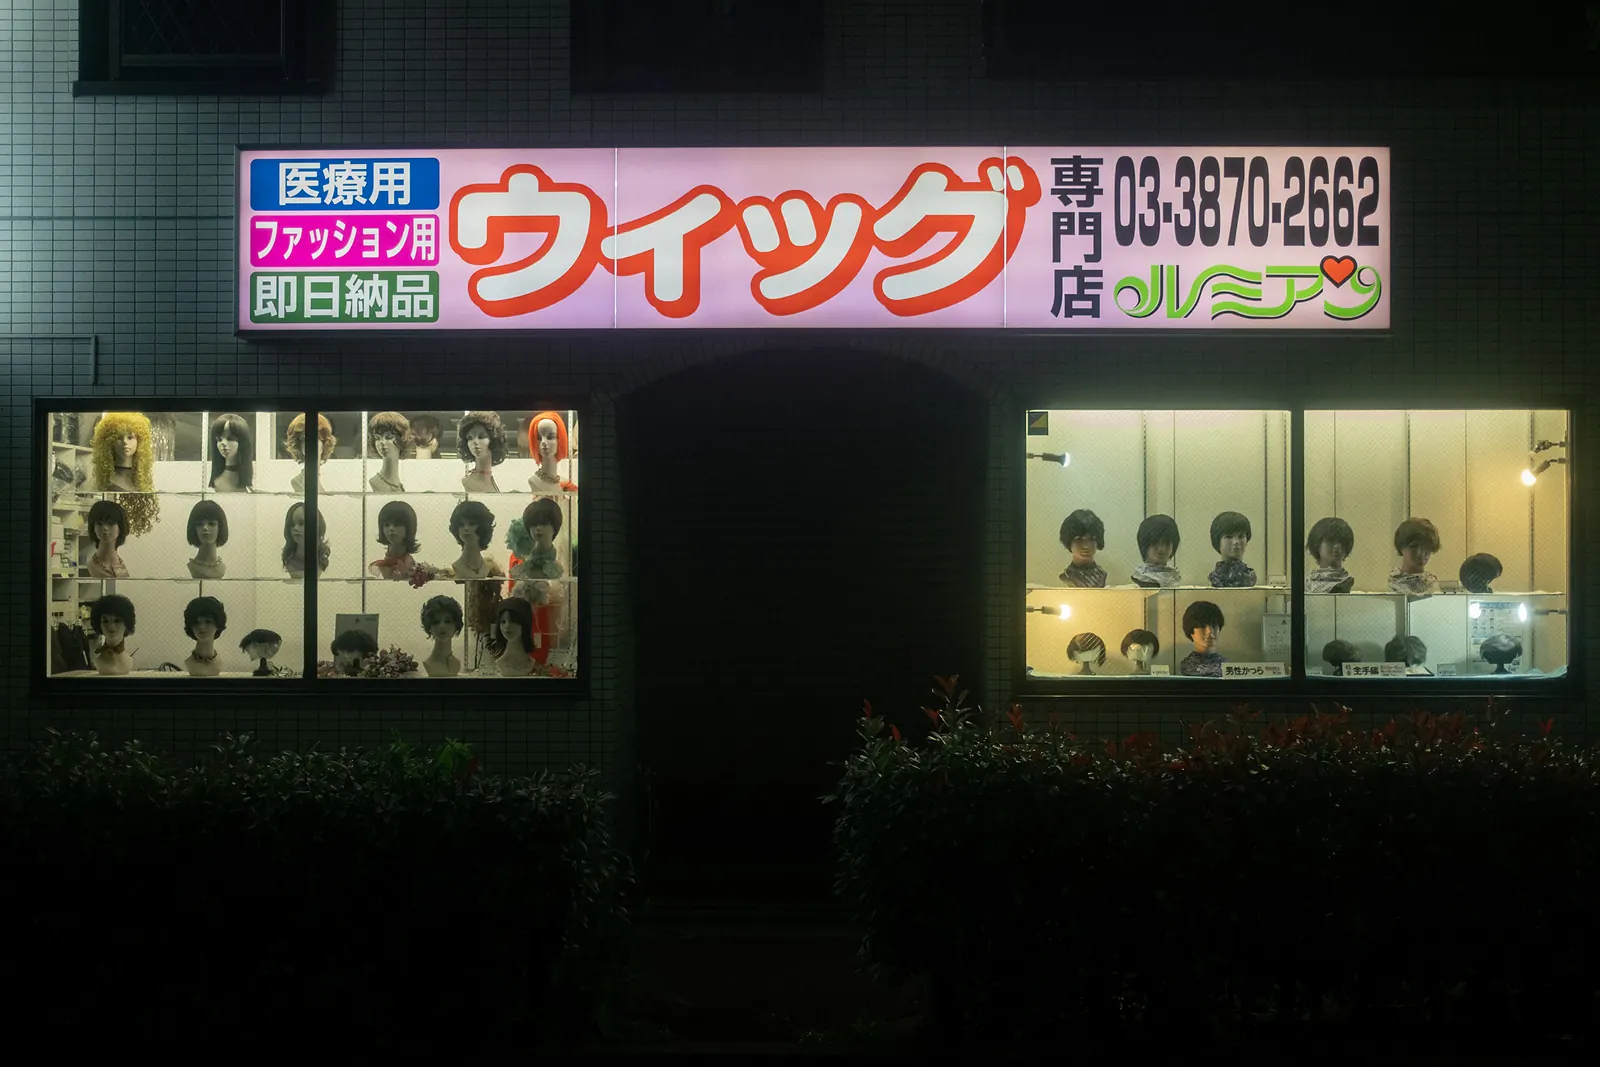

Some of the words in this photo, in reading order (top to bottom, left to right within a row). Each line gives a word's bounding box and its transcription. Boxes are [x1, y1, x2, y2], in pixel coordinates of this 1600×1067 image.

[279, 161, 411, 206] 医療用
[1114, 155, 1380, 247] 03-3870-2662
[255, 218, 437, 261] ファッション用
[449, 156, 1042, 318] ウィッグ
[1050, 155, 1104, 318] 専門店
[254, 273, 434, 319] 即日納品
[1114, 255, 1382, 320] ルミアン
[1226, 666, 1264, 676] 男性かつら
